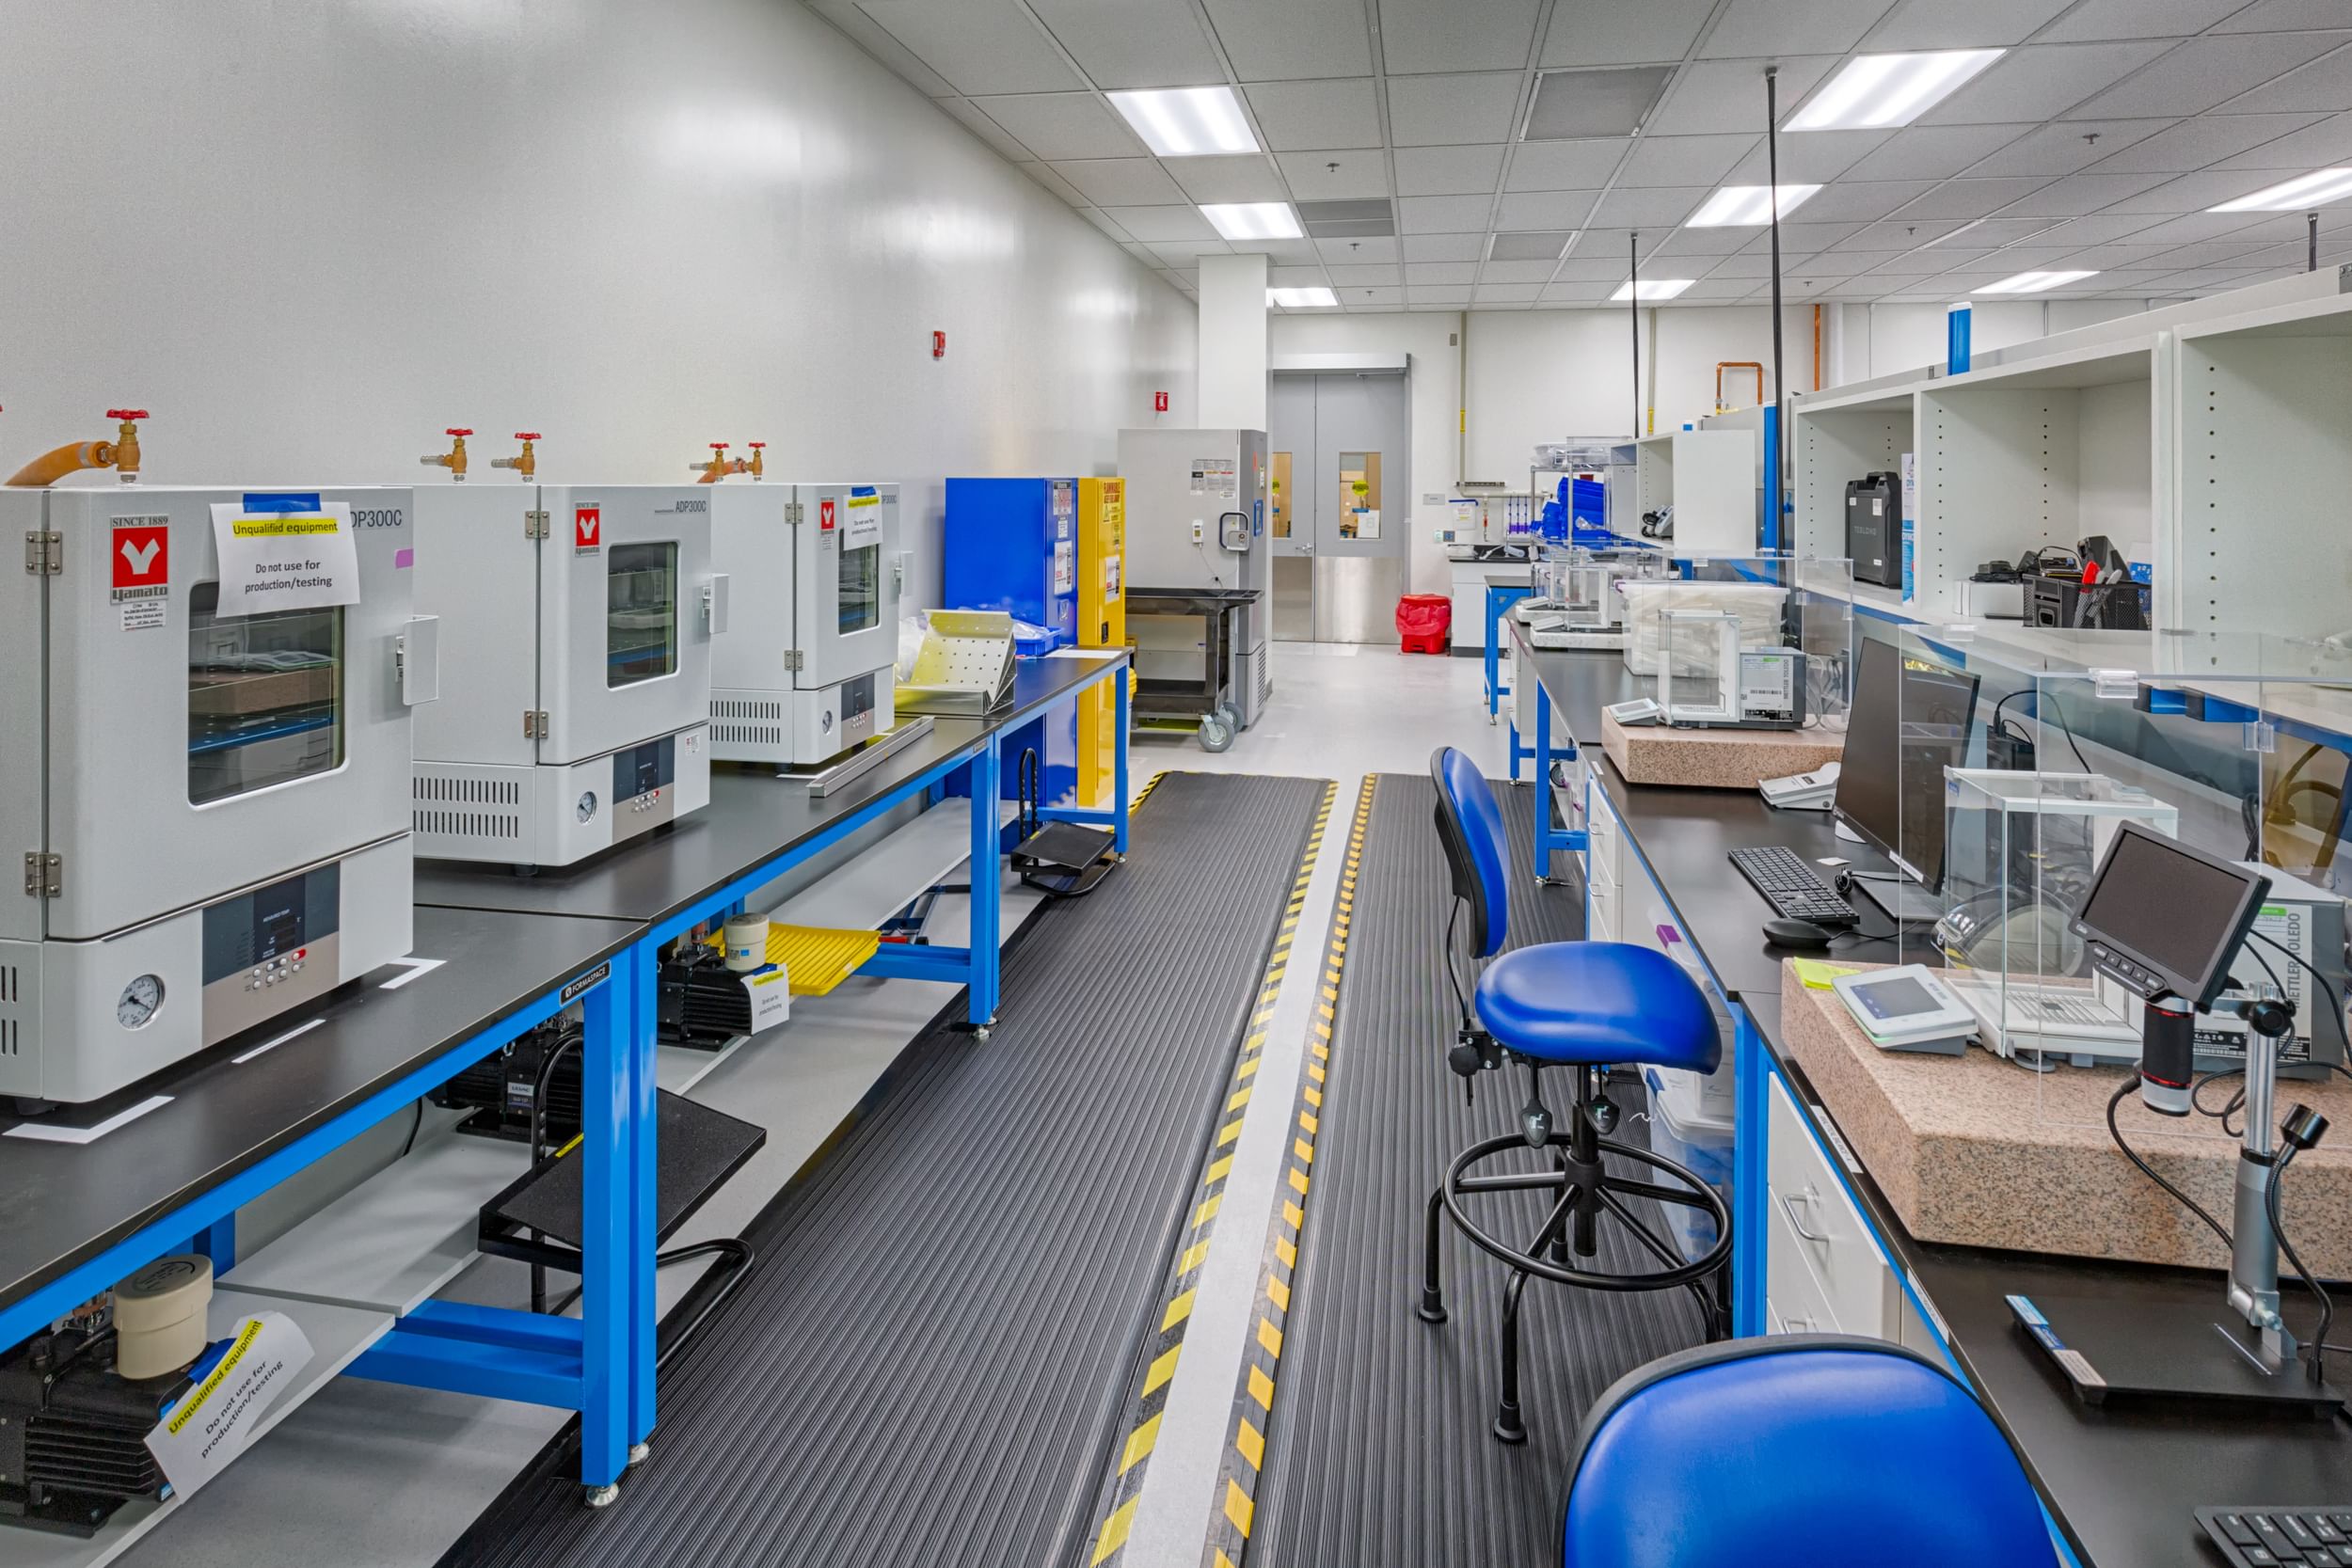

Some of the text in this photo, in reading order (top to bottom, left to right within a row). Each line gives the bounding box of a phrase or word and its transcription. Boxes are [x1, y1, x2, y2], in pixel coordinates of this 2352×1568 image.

[675, 500, 707, 512] ADP300C
[113, 515, 168, 527] SINCE 1889
[233, 522, 338, 536] Unqualified equipment
[256, 560, 321, 573] Do not use for
[245, 576, 333, 594] production/testing
[573, 966, 606, 993] FORMASPACE
[168, 1320, 263, 1434] Unqualified equipment
[205, 1361, 267, 1434] Do not use for
[201, 1360, 283, 1459] production/testing
